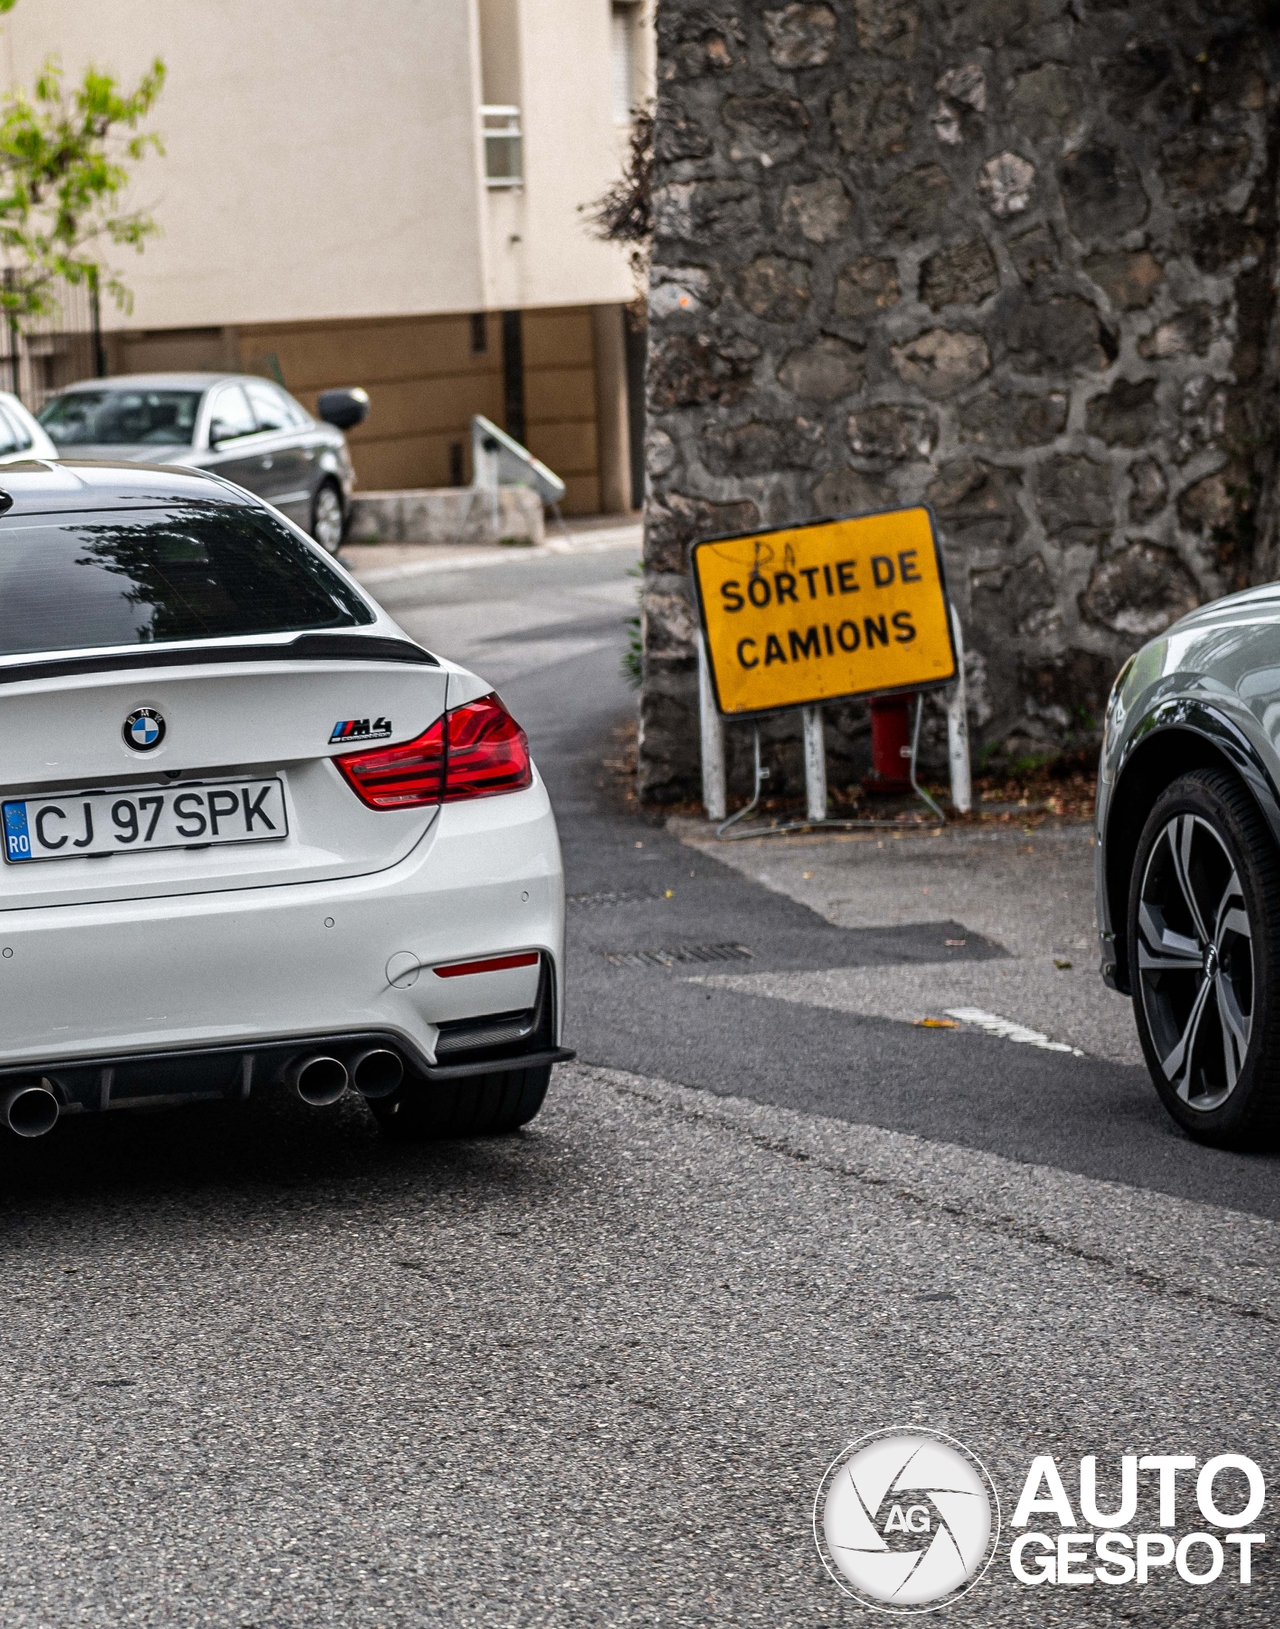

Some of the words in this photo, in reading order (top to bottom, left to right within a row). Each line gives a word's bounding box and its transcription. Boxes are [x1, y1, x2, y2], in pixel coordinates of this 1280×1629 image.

[721, 560, 860, 613] SORTIE
[870, 549, 922, 589] DE
[737, 611, 917, 671] CAMIONS
[127, 709, 163, 725] BMW
[349, 717, 392, 736] M4
[35, 802, 94, 849] CJ
[111, 795, 165, 844] 97
[172, 785, 277, 838] SPK
[8, 835, 29, 853] RO
